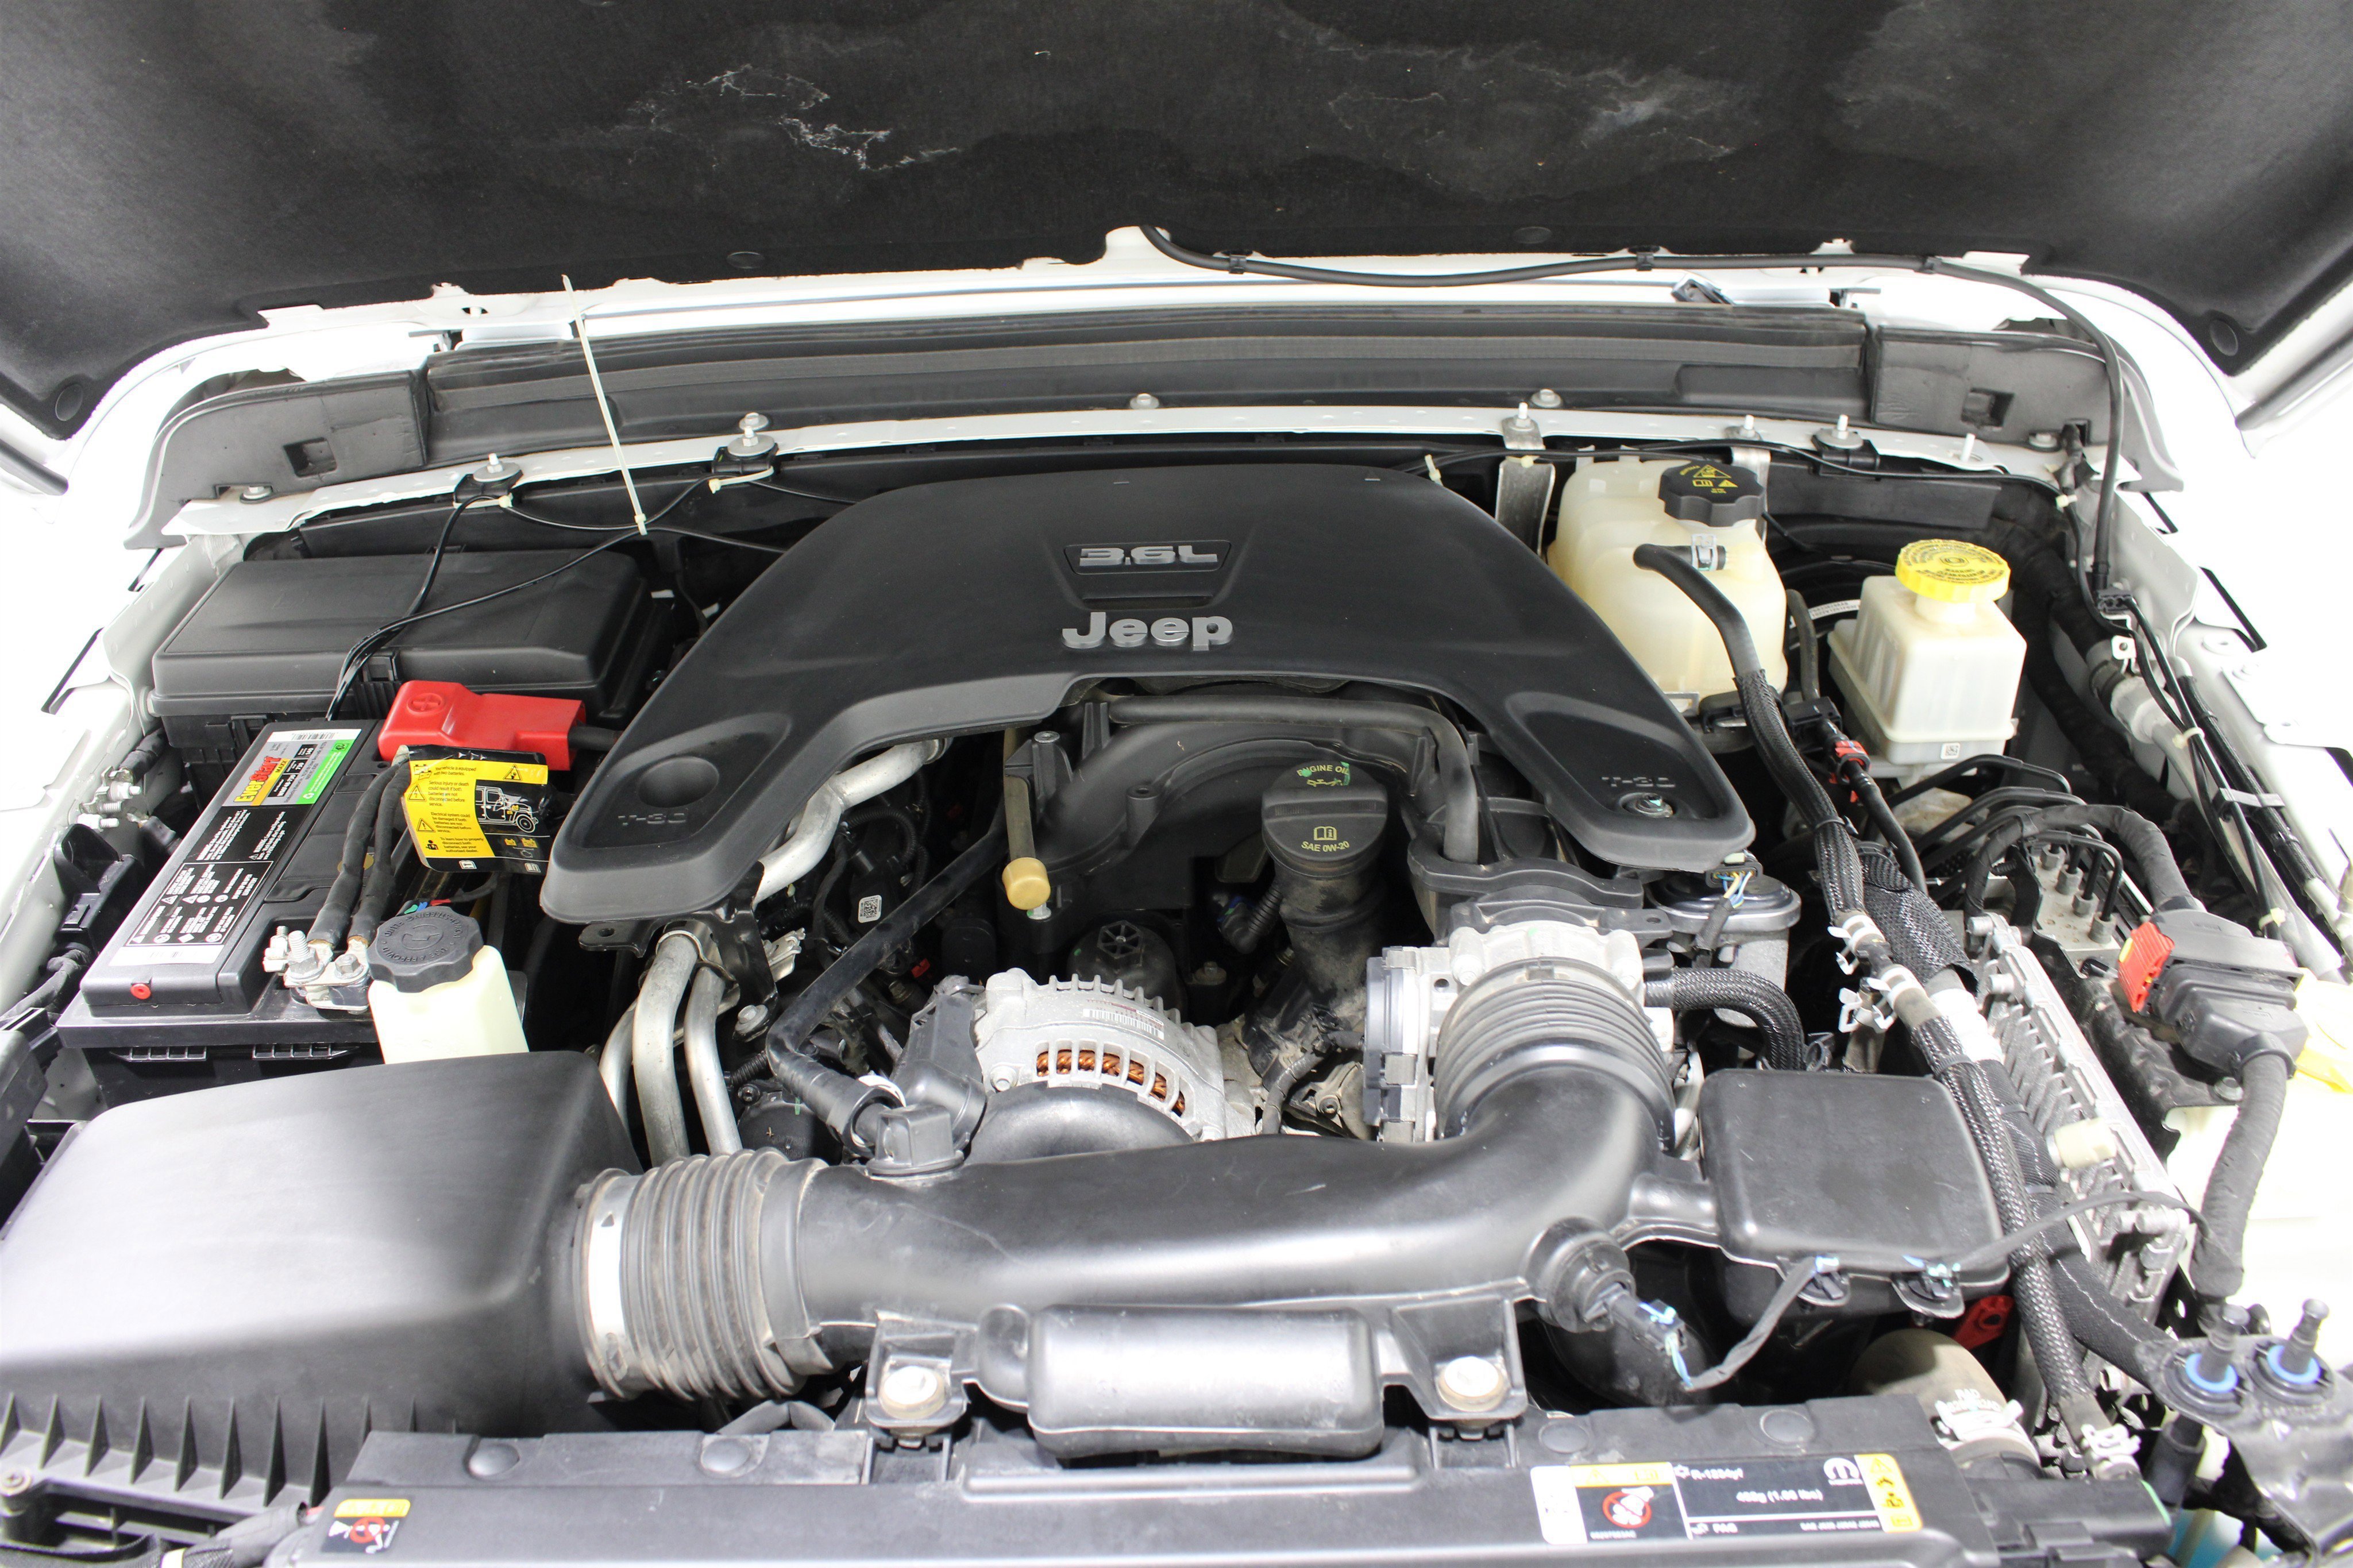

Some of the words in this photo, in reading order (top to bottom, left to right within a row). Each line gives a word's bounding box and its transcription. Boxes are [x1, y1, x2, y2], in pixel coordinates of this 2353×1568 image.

[1079, 544, 1218, 566] 3.6L
[1062, 612, 1233, 651] Jeep
[234, 756, 283, 802] EverStart
[1296, 764, 1333, 777] EGINE
[1301, 841, 1321, 852] SAE
[1322, 840, 1350, 852] 0W-20
